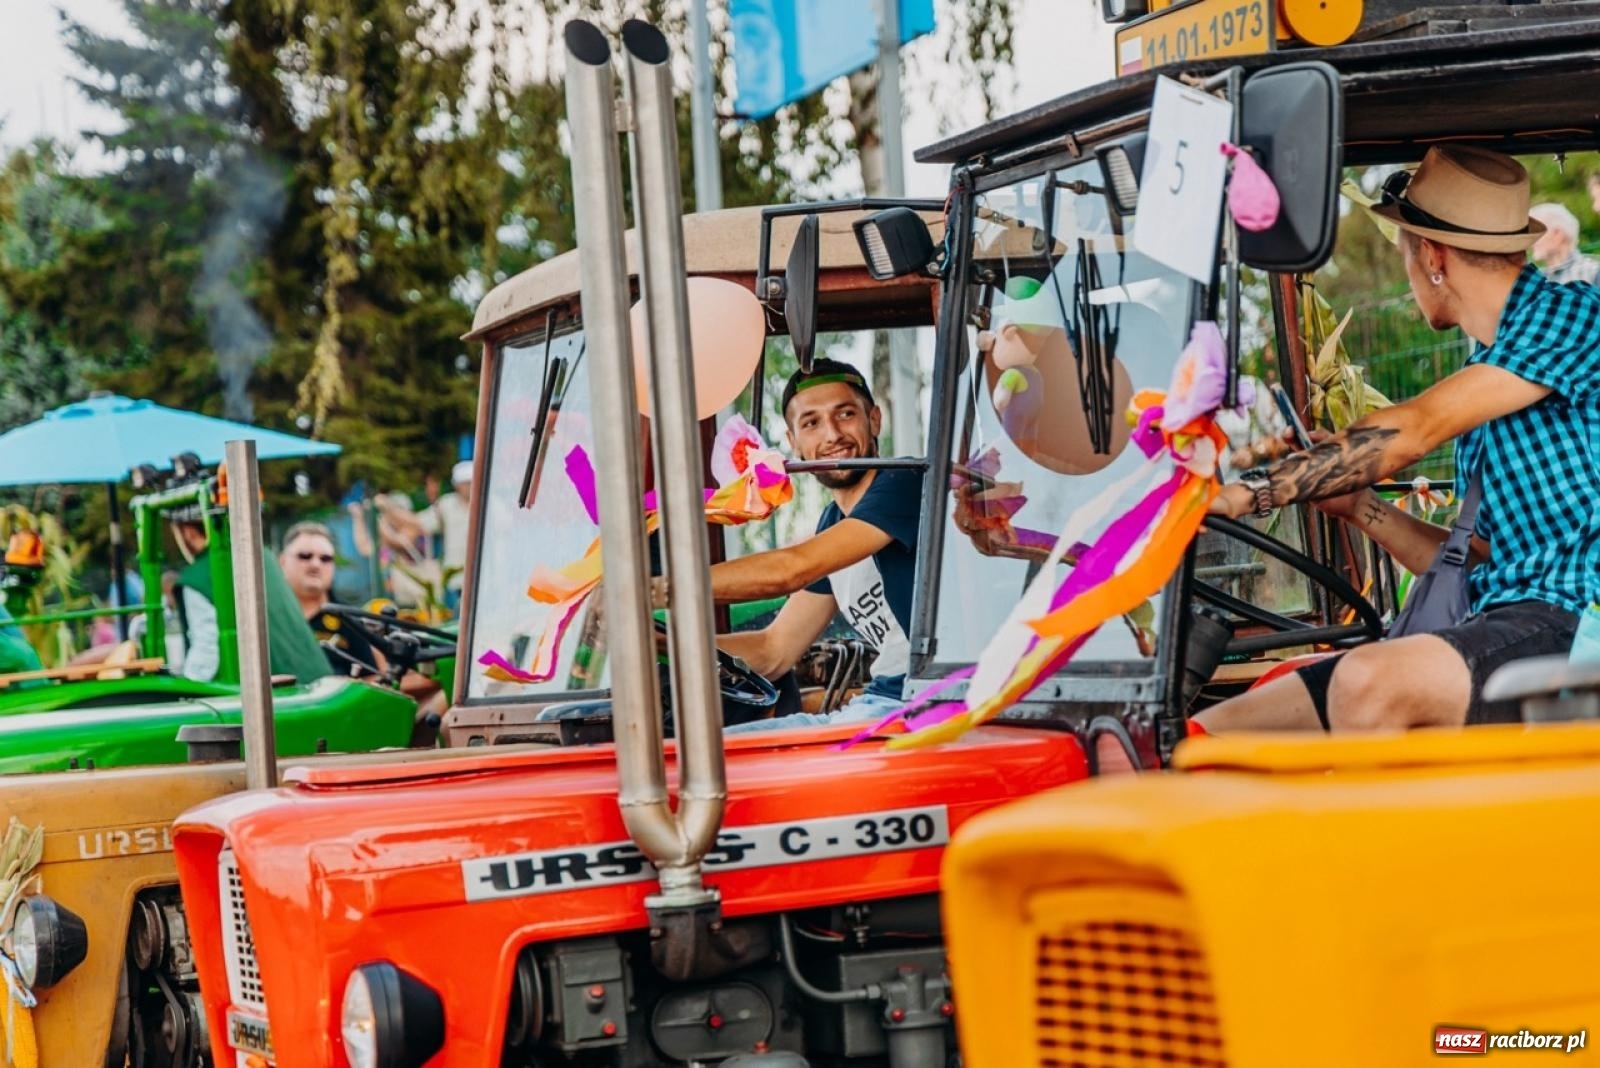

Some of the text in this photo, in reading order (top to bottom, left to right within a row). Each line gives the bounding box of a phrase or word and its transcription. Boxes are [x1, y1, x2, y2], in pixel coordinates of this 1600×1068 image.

[1147, 1, 1264, 66] 11.01.1973
[1169, 139, 1189, 195] 5
[481, 832, 756, 891] URSS
[779, 826, 810, 857] C
[855, 813, 935, 849] 330
